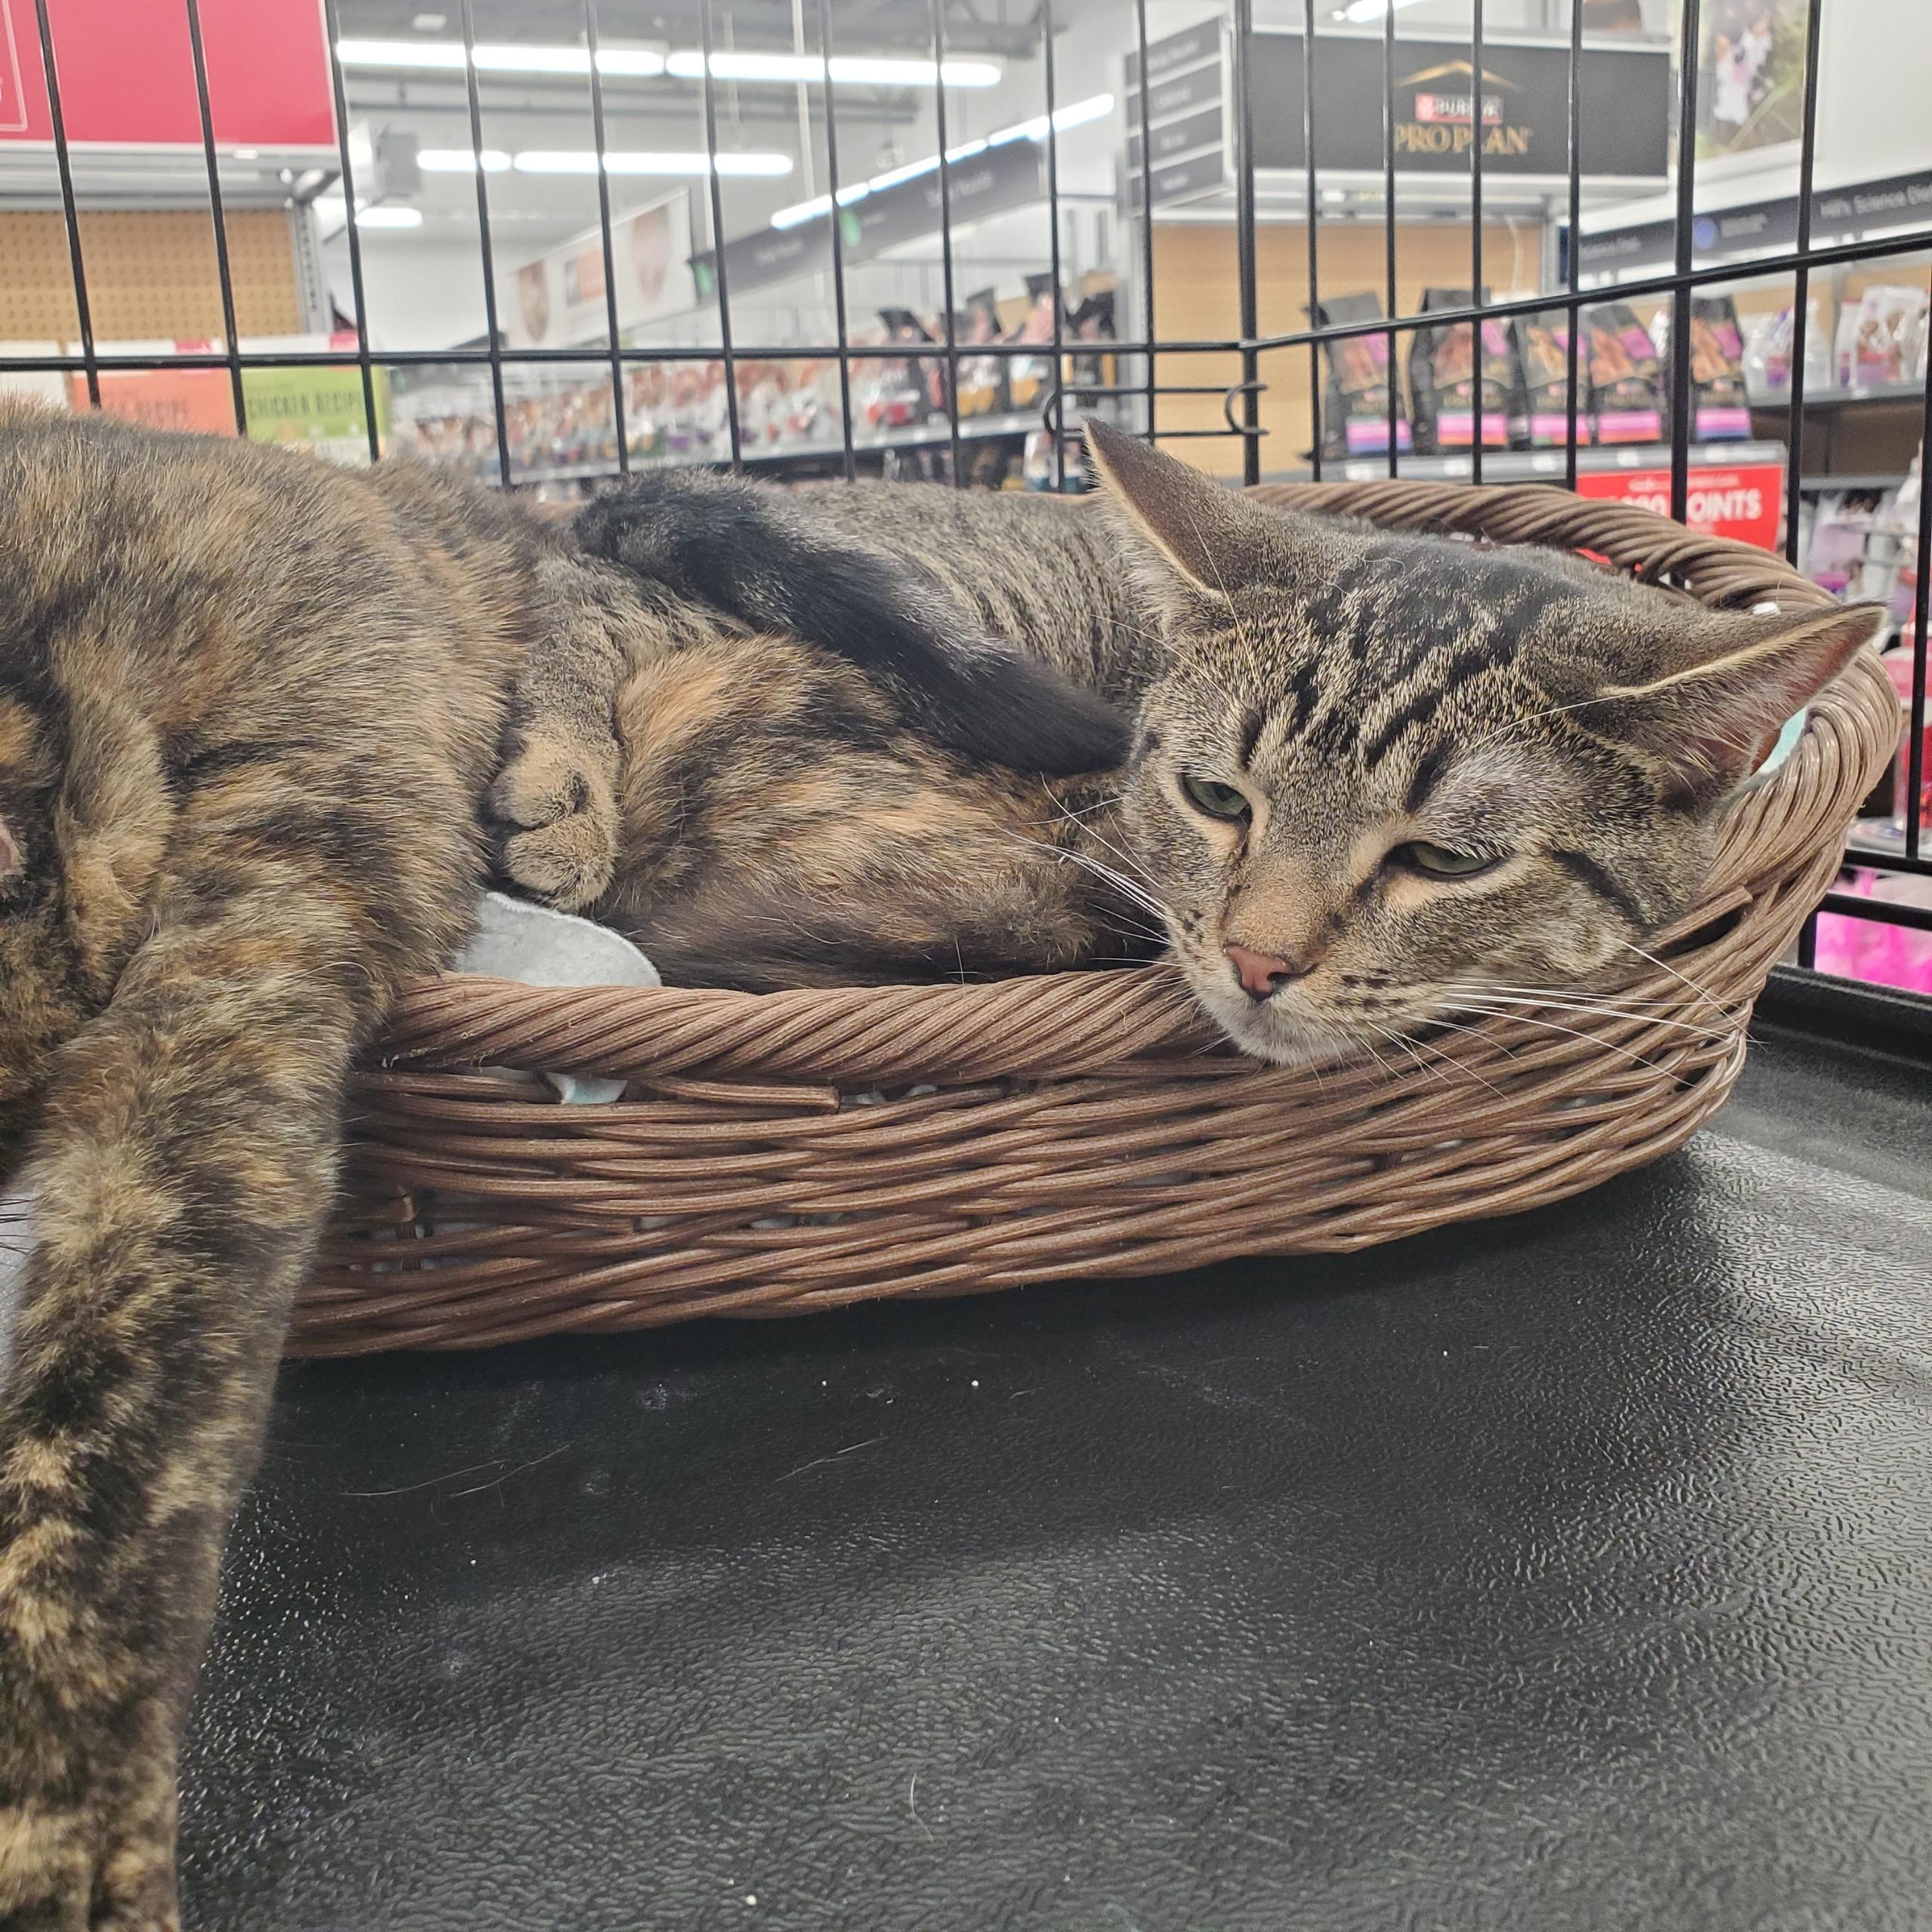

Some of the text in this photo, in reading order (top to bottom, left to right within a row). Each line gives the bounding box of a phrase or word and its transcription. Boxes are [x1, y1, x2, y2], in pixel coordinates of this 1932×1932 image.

[1435, 97, 1499, 118] PURIA
[1394, 123, 1531, 155] PRO PAN
[1853, 190, 1907, 214] Science
[248, 392, 311, 419] CHICKEN
[1686, 488, 1763, 522] OINTS
